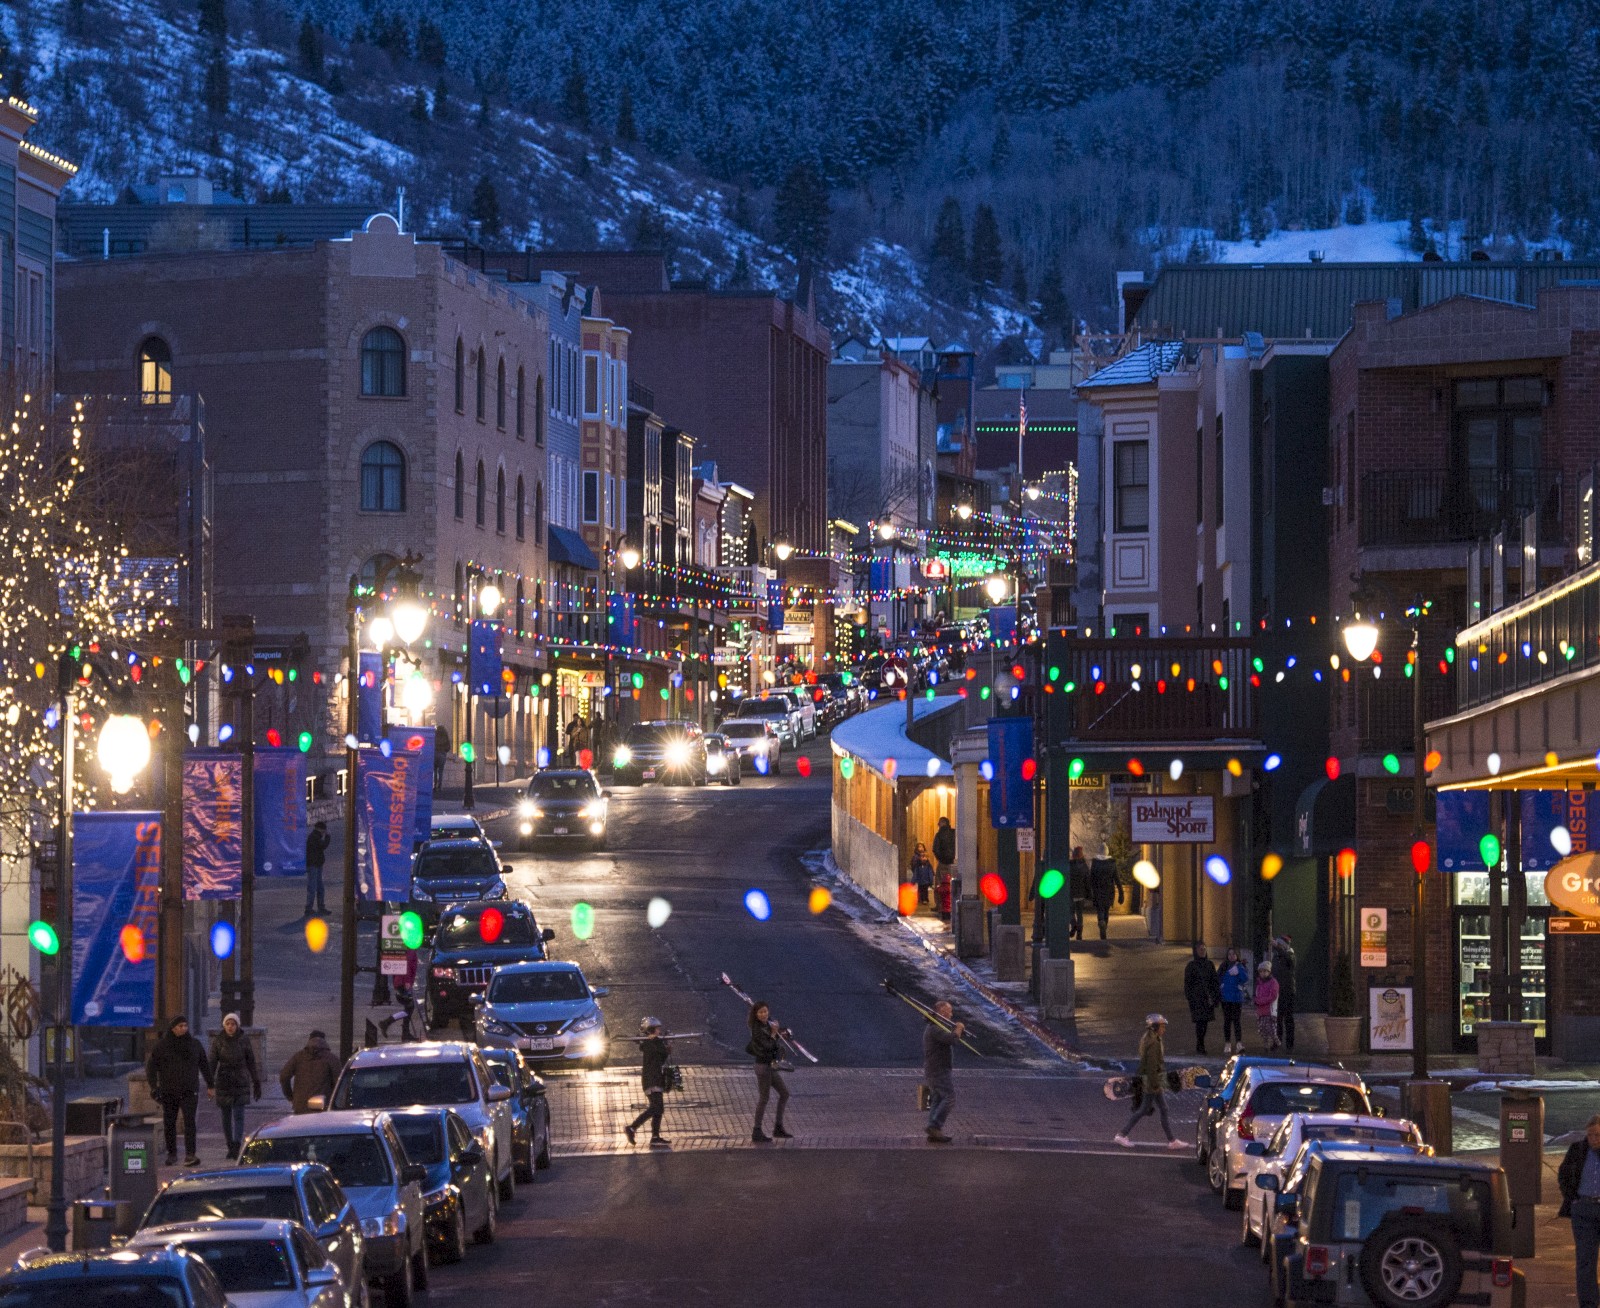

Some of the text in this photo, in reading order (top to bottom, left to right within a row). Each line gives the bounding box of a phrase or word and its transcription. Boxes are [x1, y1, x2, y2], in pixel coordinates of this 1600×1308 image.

[252, 651, 282, 660] atagonia
[1392, 787, 1437, 800] TON
[387, 756, 408, 855] OBSESSION
[134, 821, 161, 960] SELFISH
[1582, 920, 1597, 931] 7th
[1364, 932, 1371, 941] 3
[384, 939, 392, 949] 3
[1372, 1021, 1394, 1040] TRY
